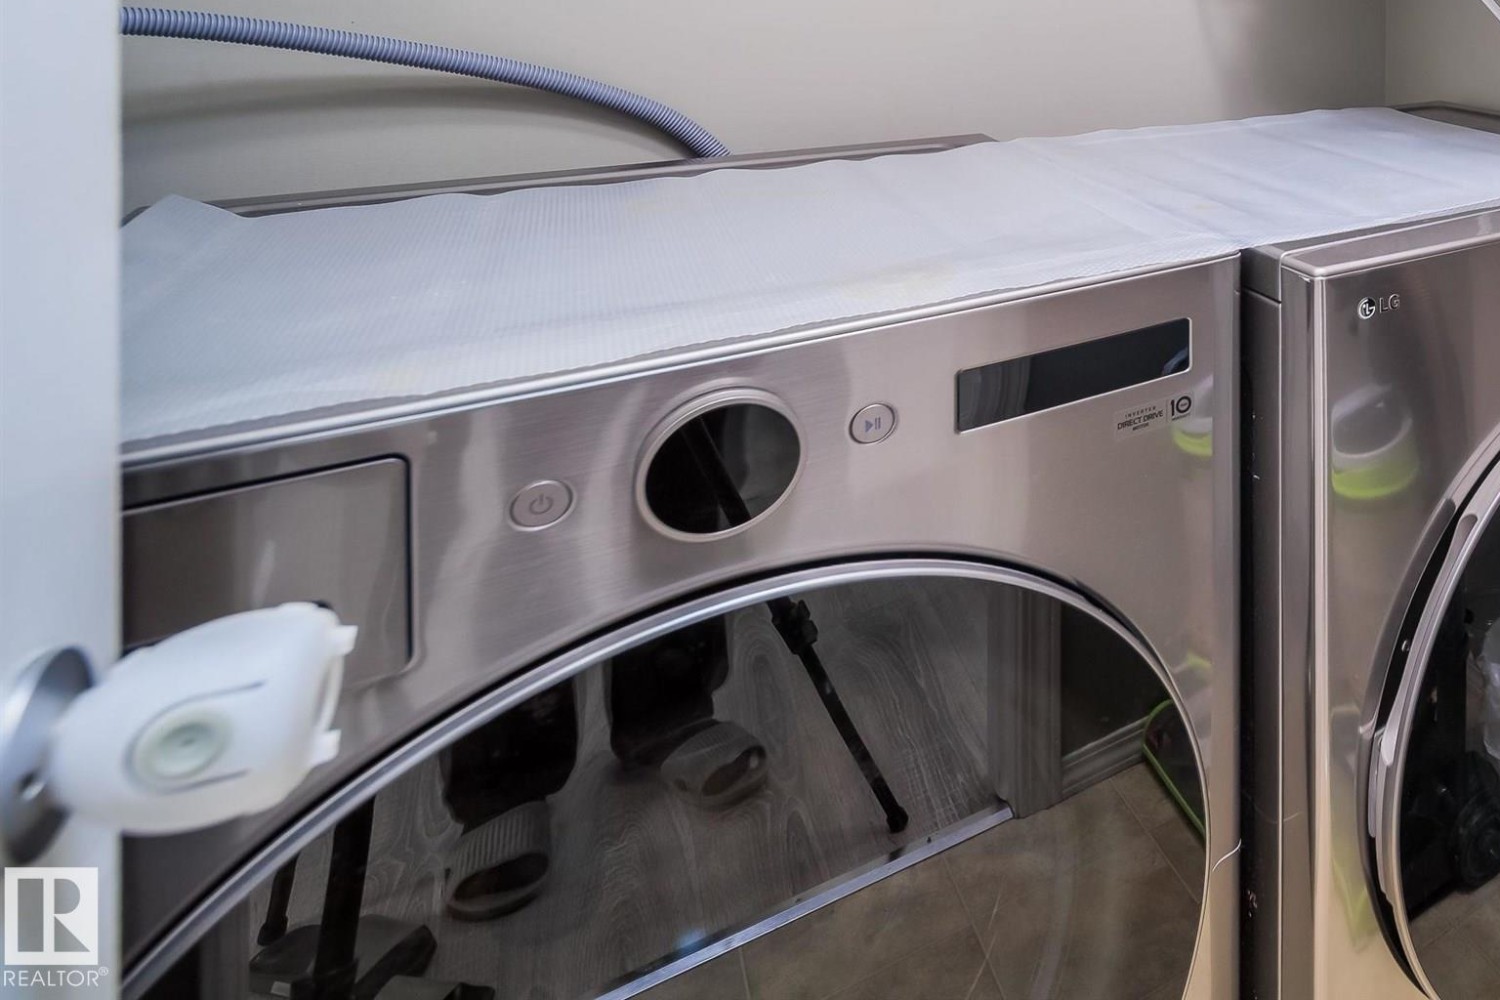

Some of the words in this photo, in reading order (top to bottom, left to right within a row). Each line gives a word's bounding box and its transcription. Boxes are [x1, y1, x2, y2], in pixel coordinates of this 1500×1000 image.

[1379, 293, 1401, 313] LG
[1117, 416, 1142, 430] DIRECT
[1143, 409, 1164, 422] DRIVE
[1170, 396, 1192, 416] 10
